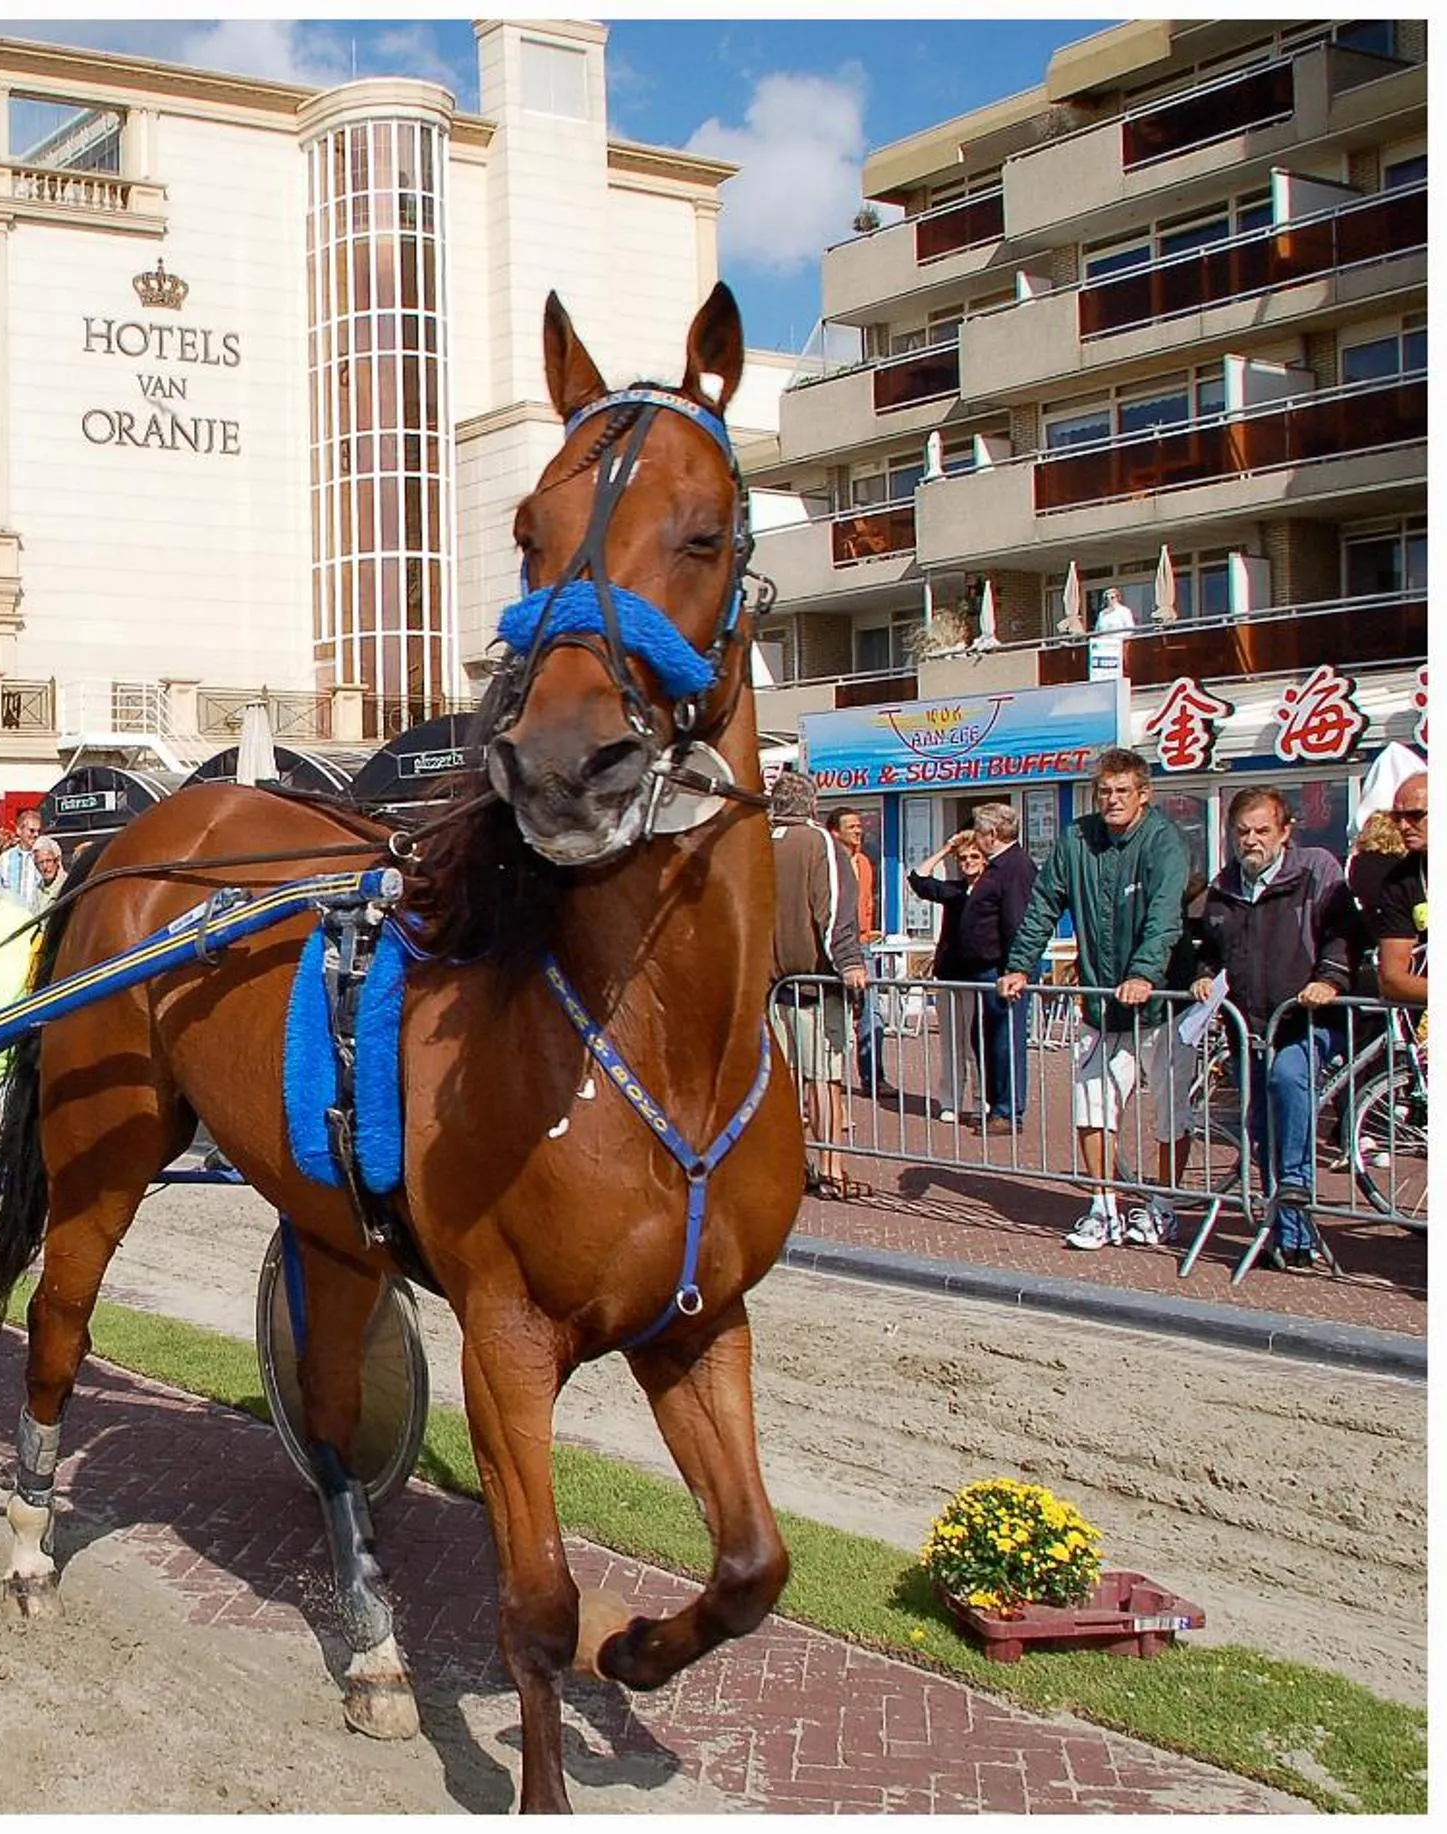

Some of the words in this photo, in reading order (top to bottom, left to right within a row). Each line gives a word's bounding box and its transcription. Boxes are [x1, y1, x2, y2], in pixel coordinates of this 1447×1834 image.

[82, 316, 242, 367] HOTELS
[136, 374, 188, 400] VAN
[81, 408, 242, 455] ORANJE
[816, 767, 869, 790] WOK
[877, 766, 897, 785] &
[904, 758, 982, 783] SUSHI
[986, 749, 1092, 779] BUFFET
